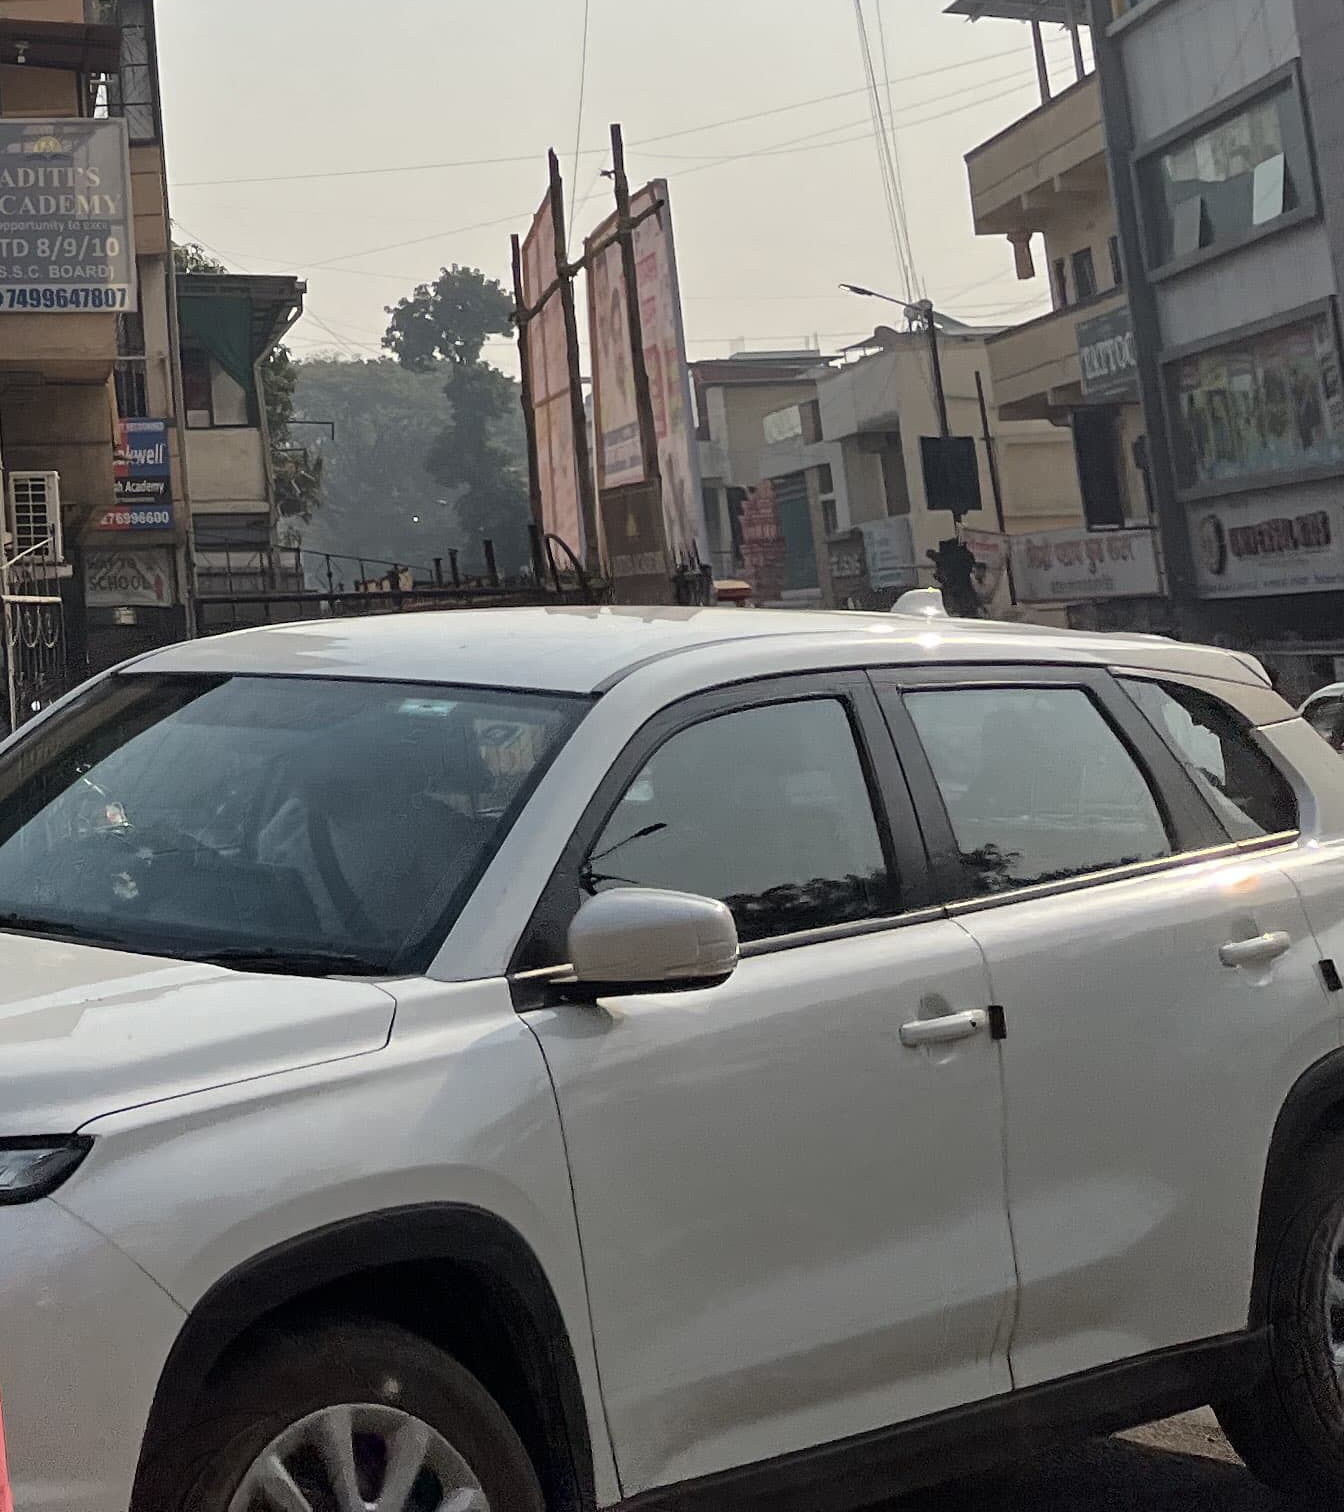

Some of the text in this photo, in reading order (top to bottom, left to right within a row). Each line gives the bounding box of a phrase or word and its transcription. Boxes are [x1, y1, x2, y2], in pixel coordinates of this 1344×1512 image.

[36, 236, 120, 261] 8/9/10
[49, 264, 116, 281] BOARD)
[6, 288, 127, 309] 7499647807
[125, 479, 164, 495] Academy
